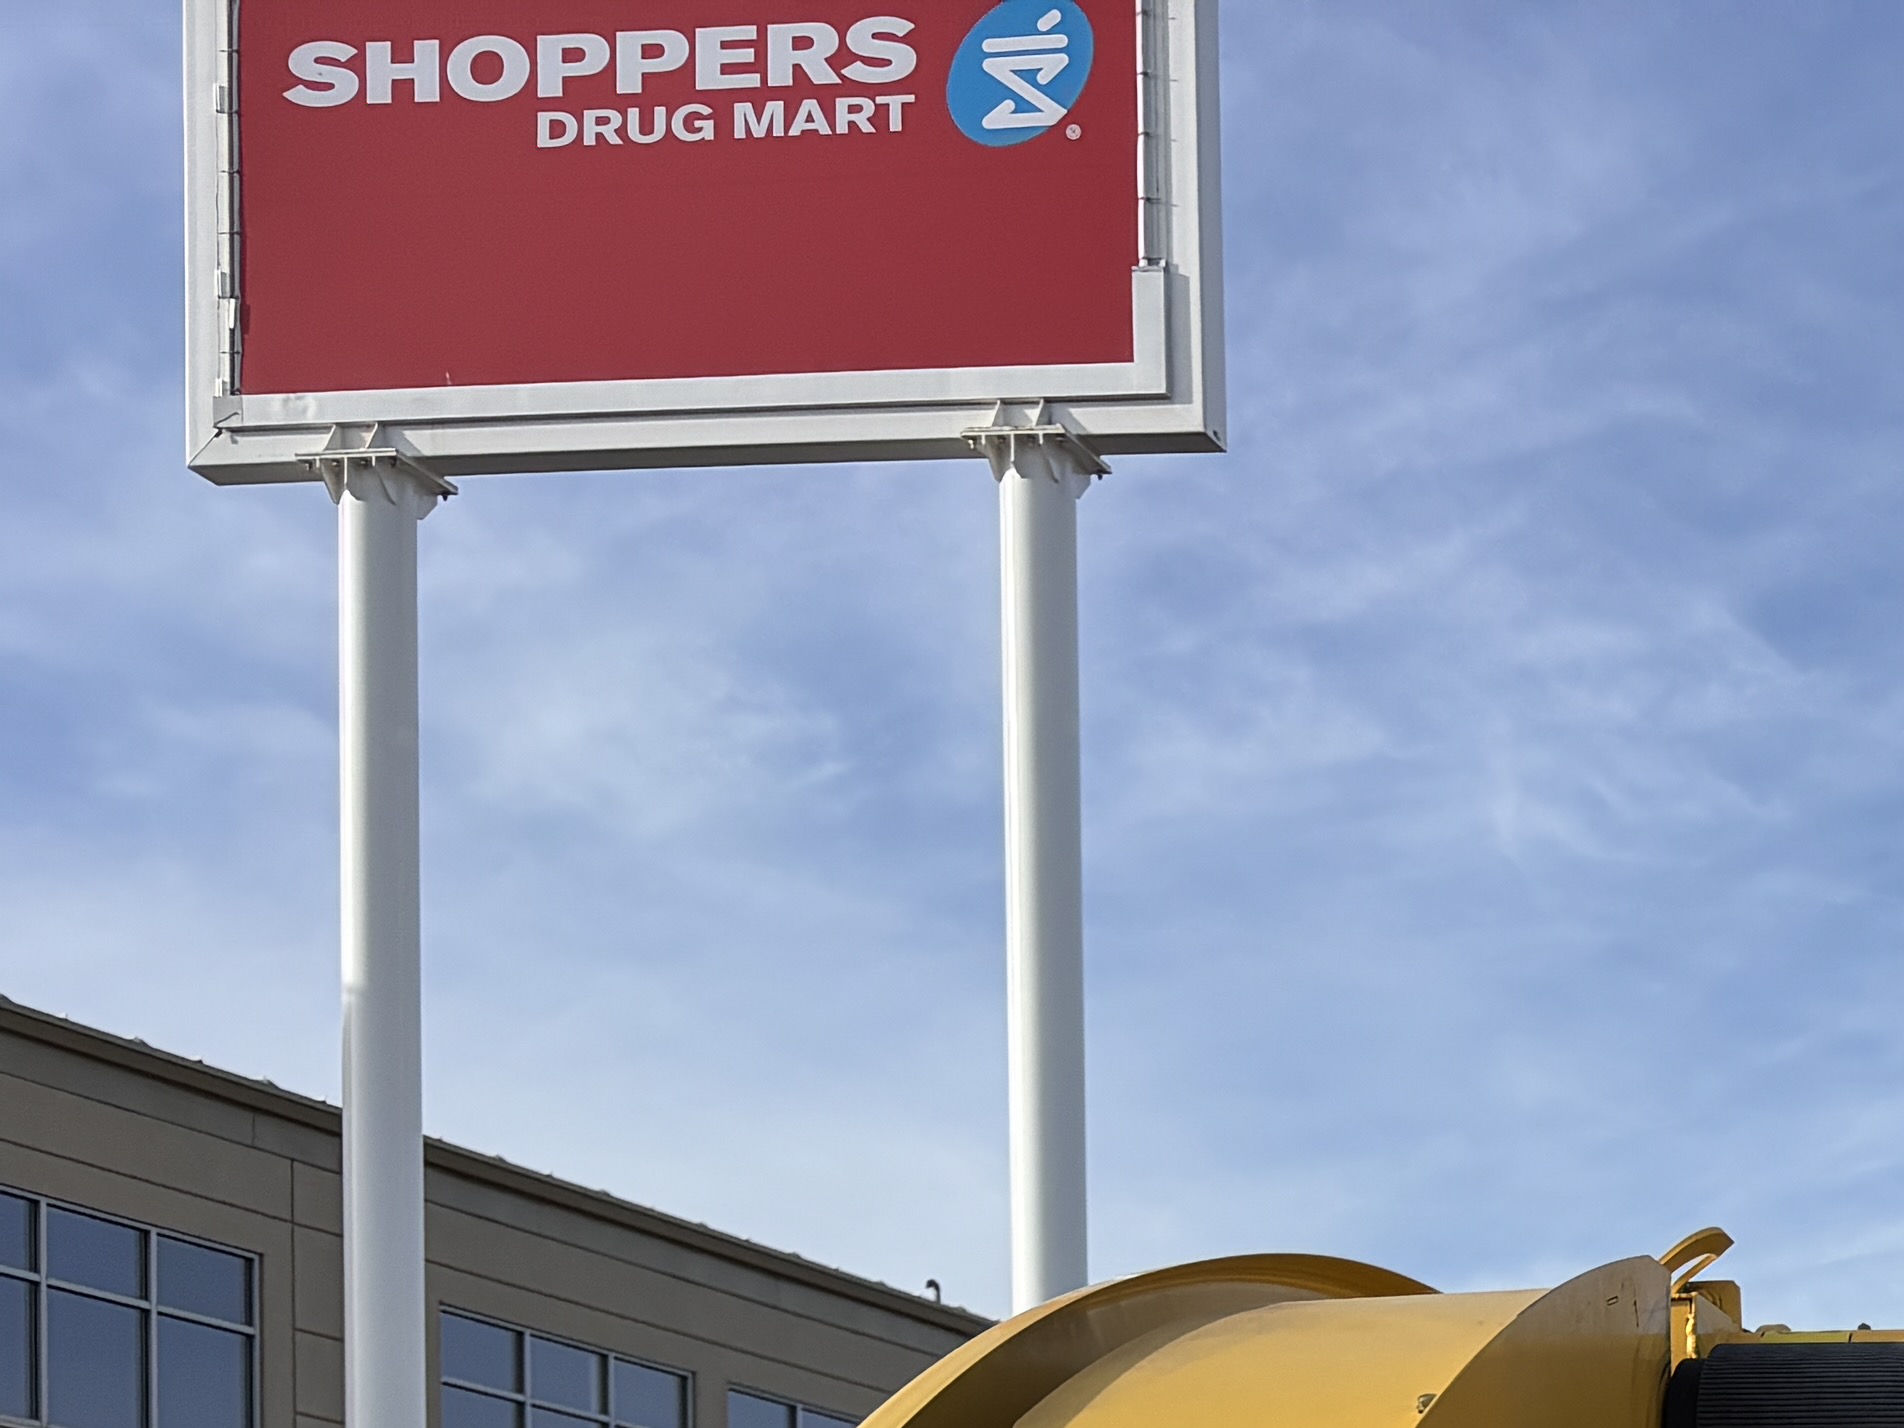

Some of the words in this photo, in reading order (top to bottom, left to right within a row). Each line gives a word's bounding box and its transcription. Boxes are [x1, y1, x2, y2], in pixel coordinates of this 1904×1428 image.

[281, 16, 916, 108] SHOPPERS
[536, 105, 714, 149] DRUG
[733, 94, 915, 140] MART
